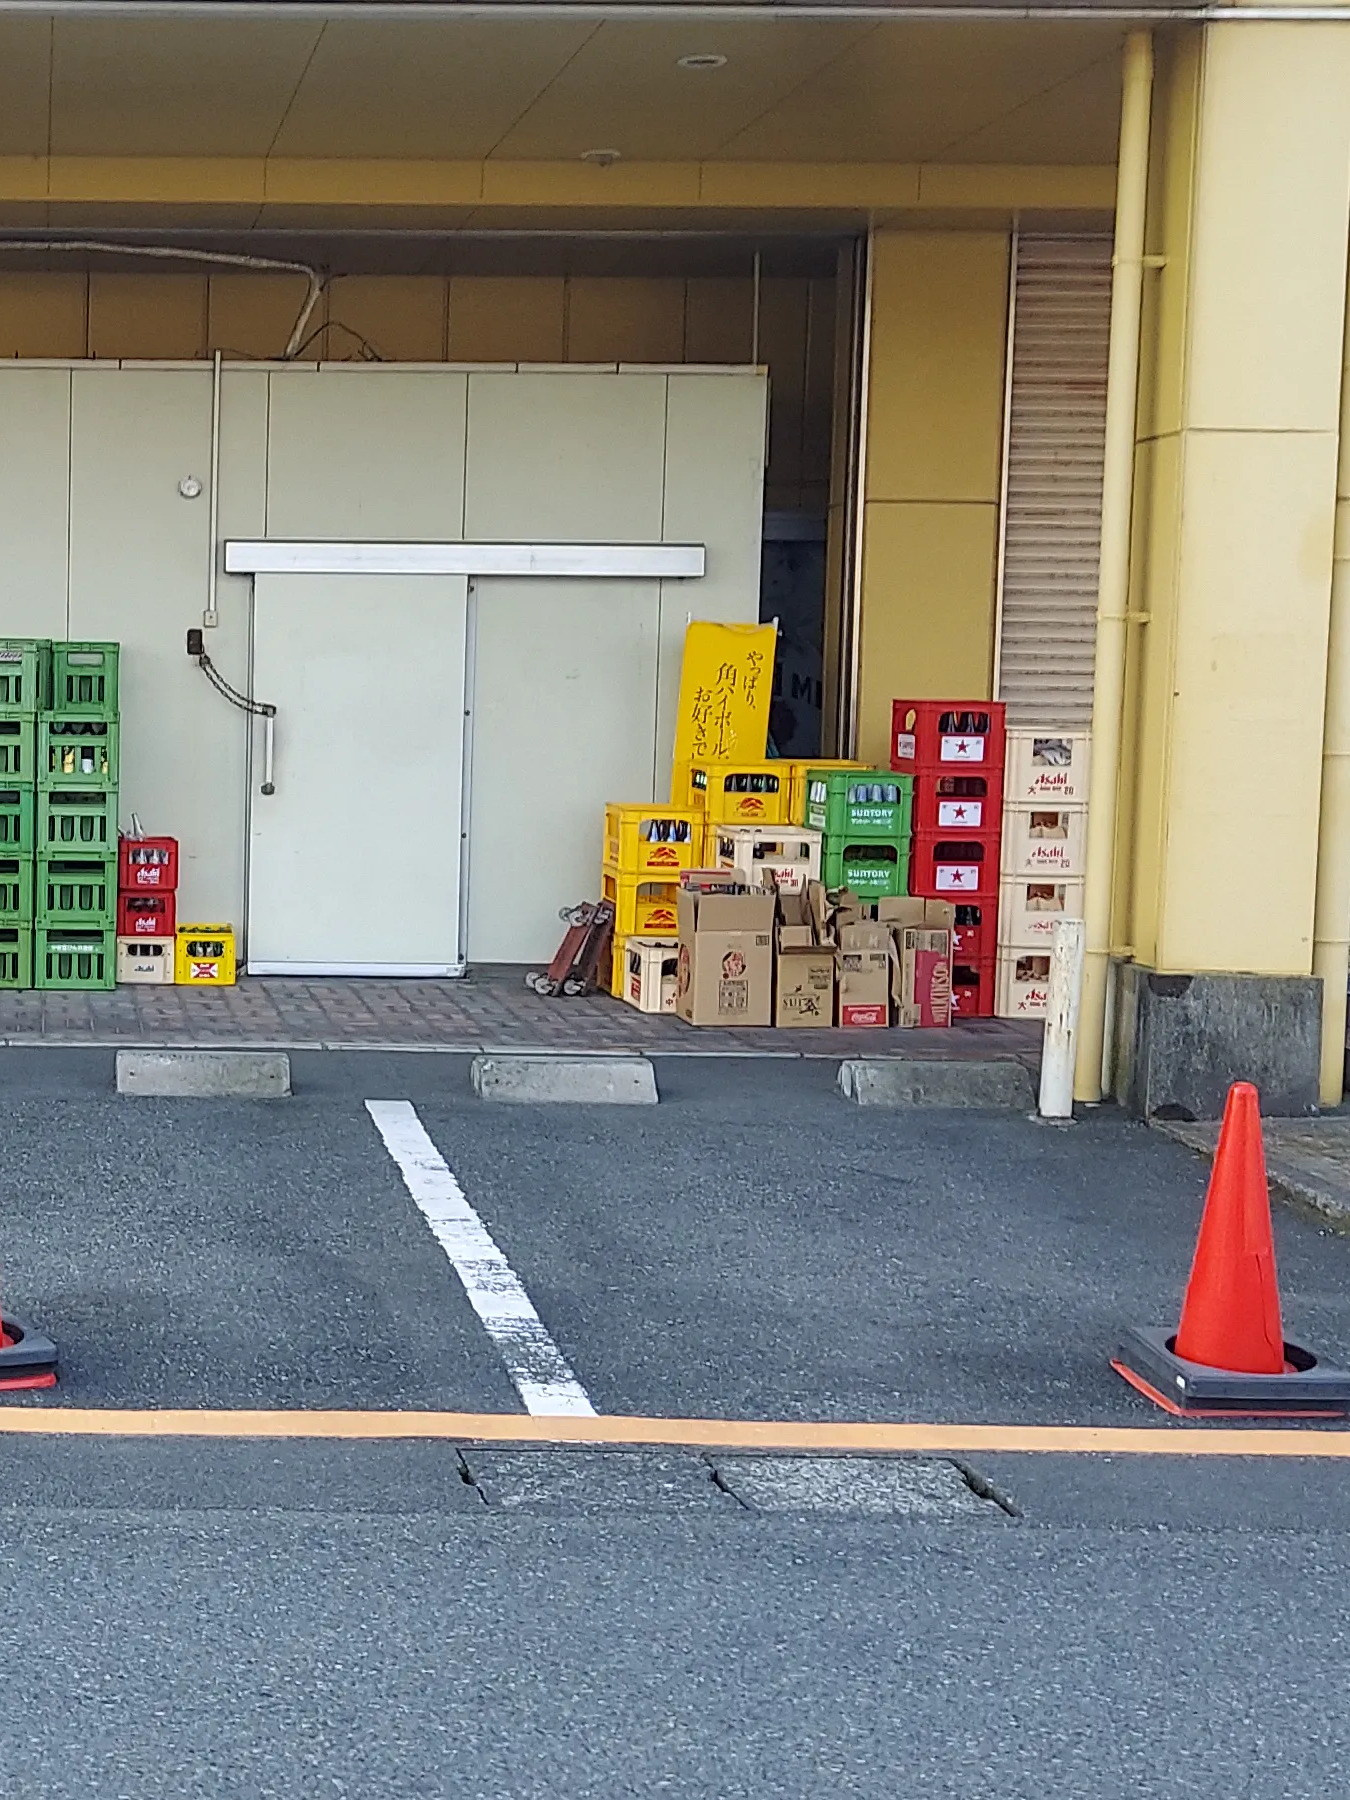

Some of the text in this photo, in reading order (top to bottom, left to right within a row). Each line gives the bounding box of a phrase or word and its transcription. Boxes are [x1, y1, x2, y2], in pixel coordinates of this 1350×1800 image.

[712, 662, 737, 759] 角ハイボール
[691, 686, 713, 759] お好きで
[1035, 772, 1068, 785] Asahi
[851, 808, 893, 818] SUNTORY
[1031, 846, 1064, 858] Asahi
[847, 869, 890, 879] SUNTORY
